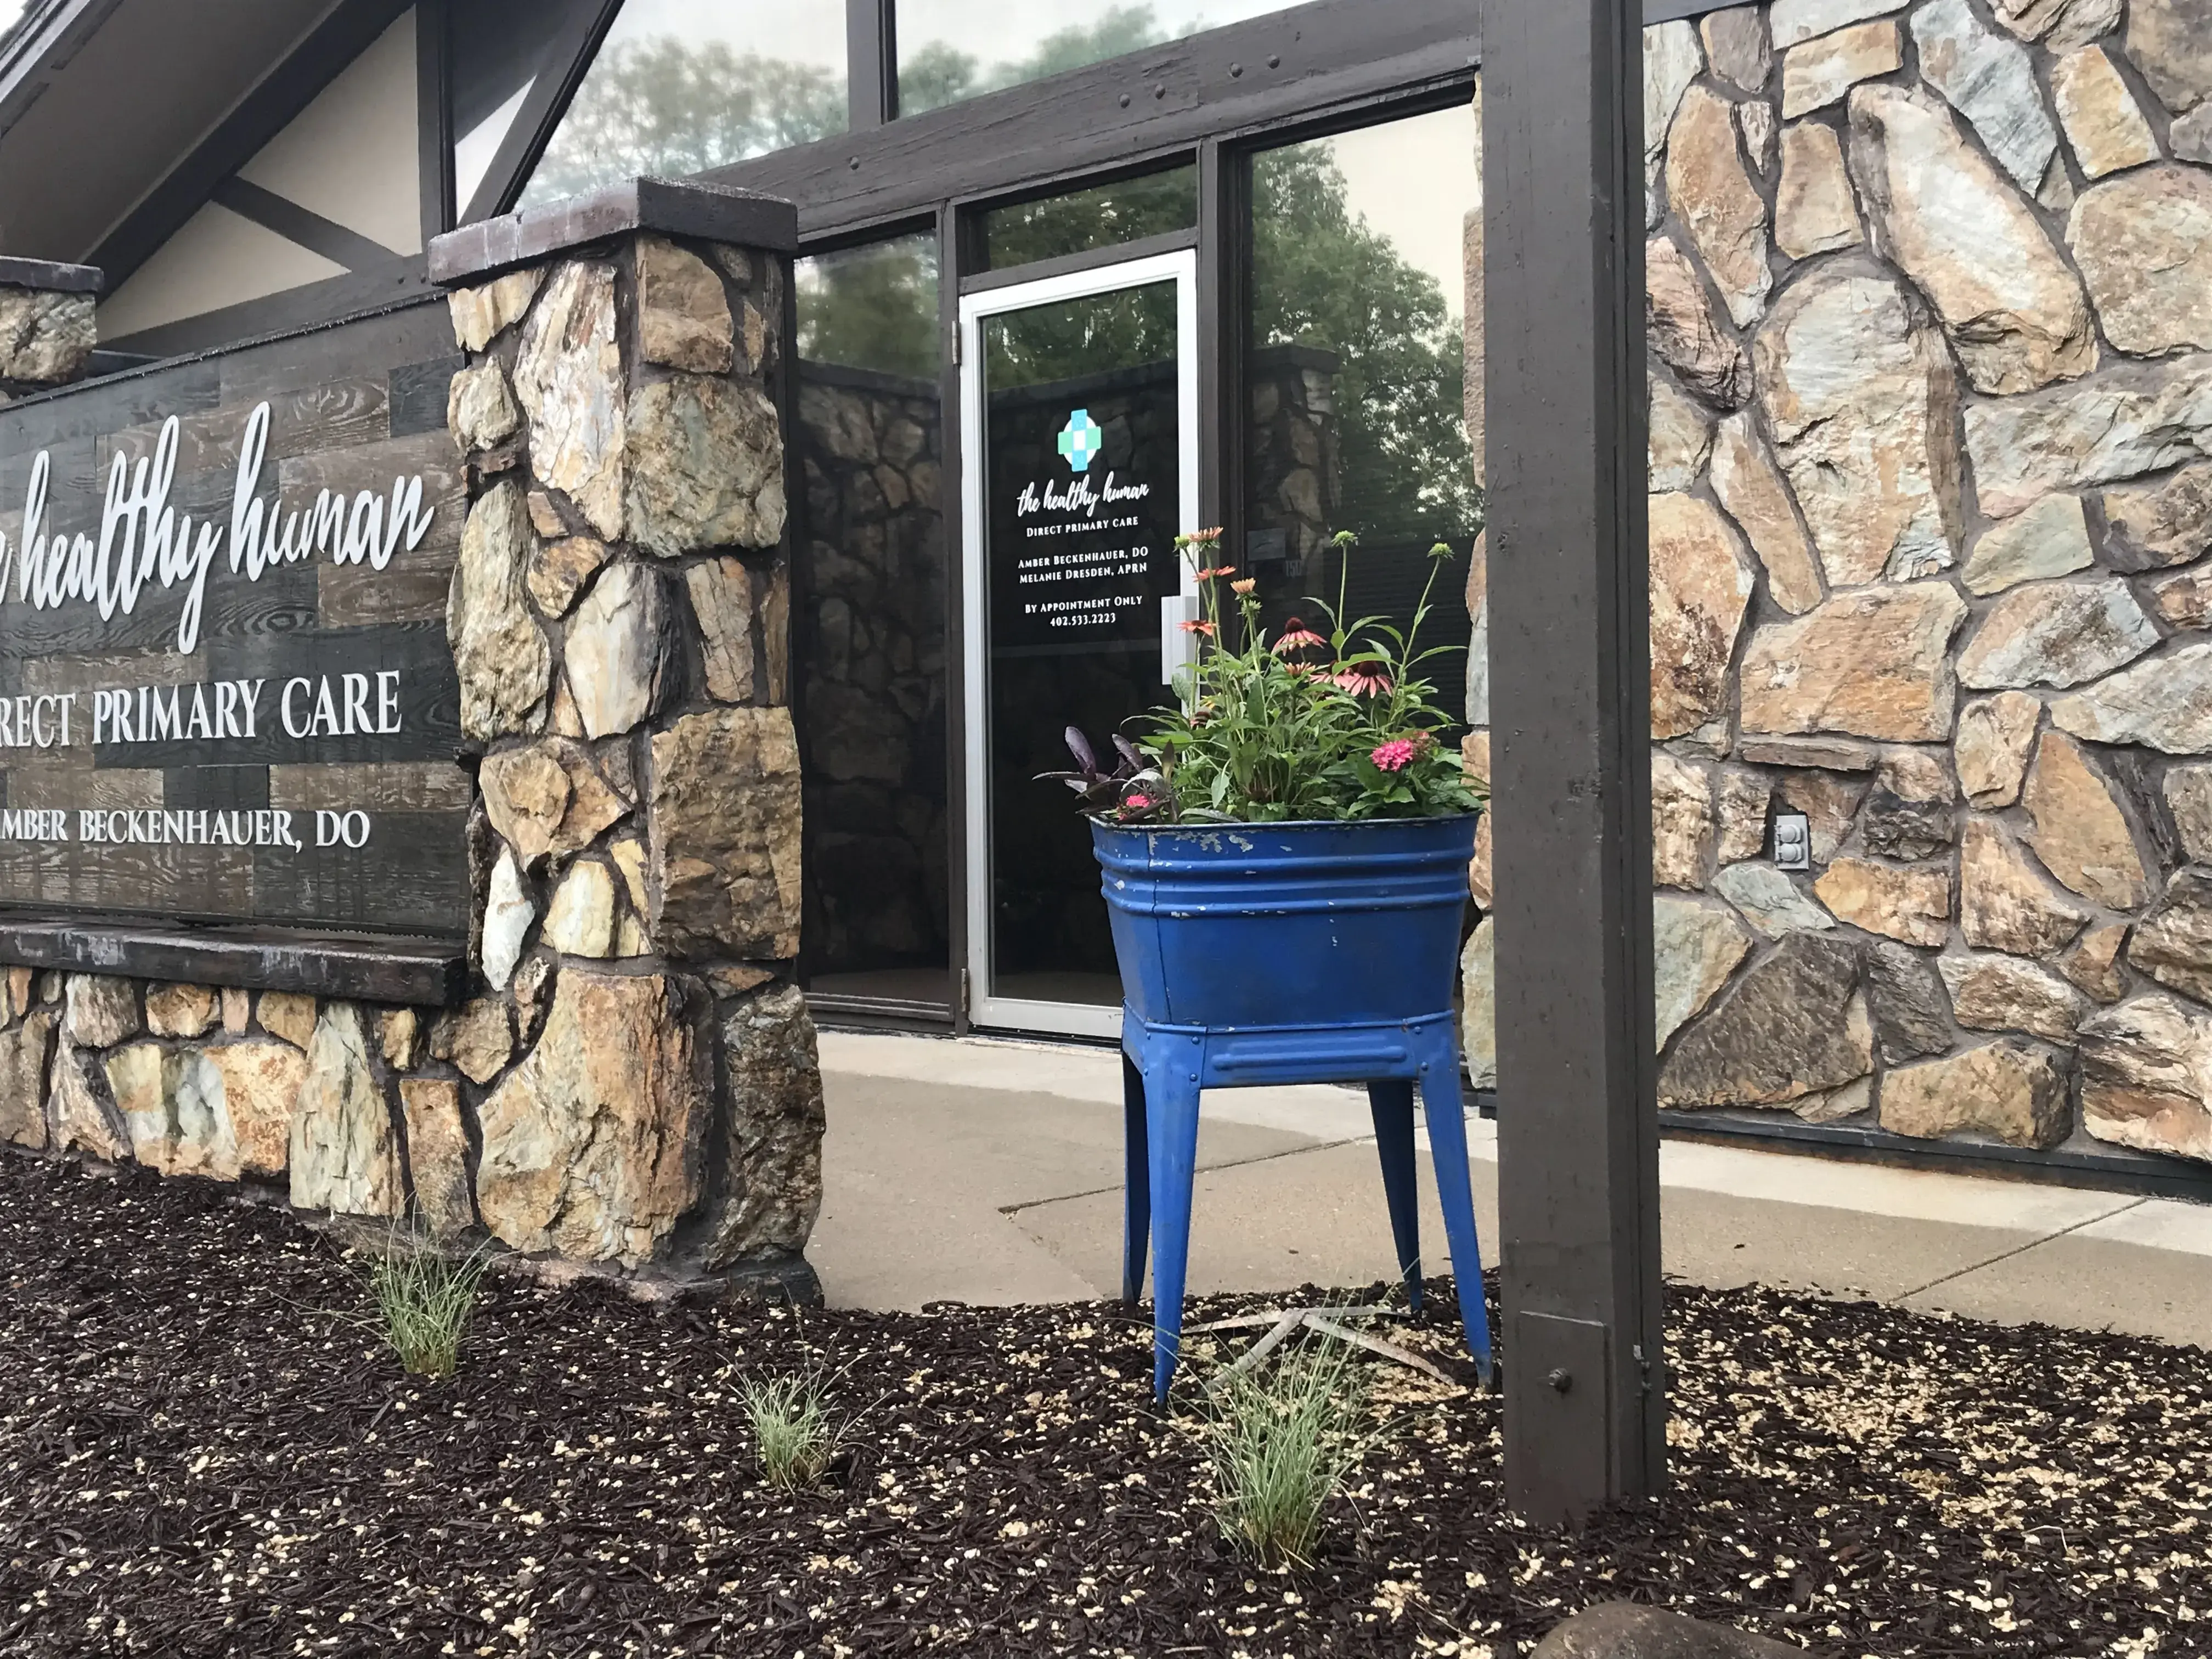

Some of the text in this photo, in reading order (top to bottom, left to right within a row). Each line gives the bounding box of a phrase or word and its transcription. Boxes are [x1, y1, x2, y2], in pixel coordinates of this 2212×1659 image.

[1017, 471, 1149, 517] the healthy human
[20, 400, 435, 654] healthy human
[1026, 516, 1138, 537] DIRECT PRIMARY CARE
[1018, 546, 1148, 569] AMBER BECKENHAUER, DO
[1019, 562, 1147, 584] MELANIE DRESDEN, APRN
[1025, 595, 1143, 613] BY APPOINTMENT ONLY
[1049, 612, 1116, 627] 402.533.2223
[92, 678, 266, 744] PRIMARY
[281, 670, 402, 738] CARE
[78, 809, 303, 854] BECKENHAUER,
[315, 810, 371, 848] DO
